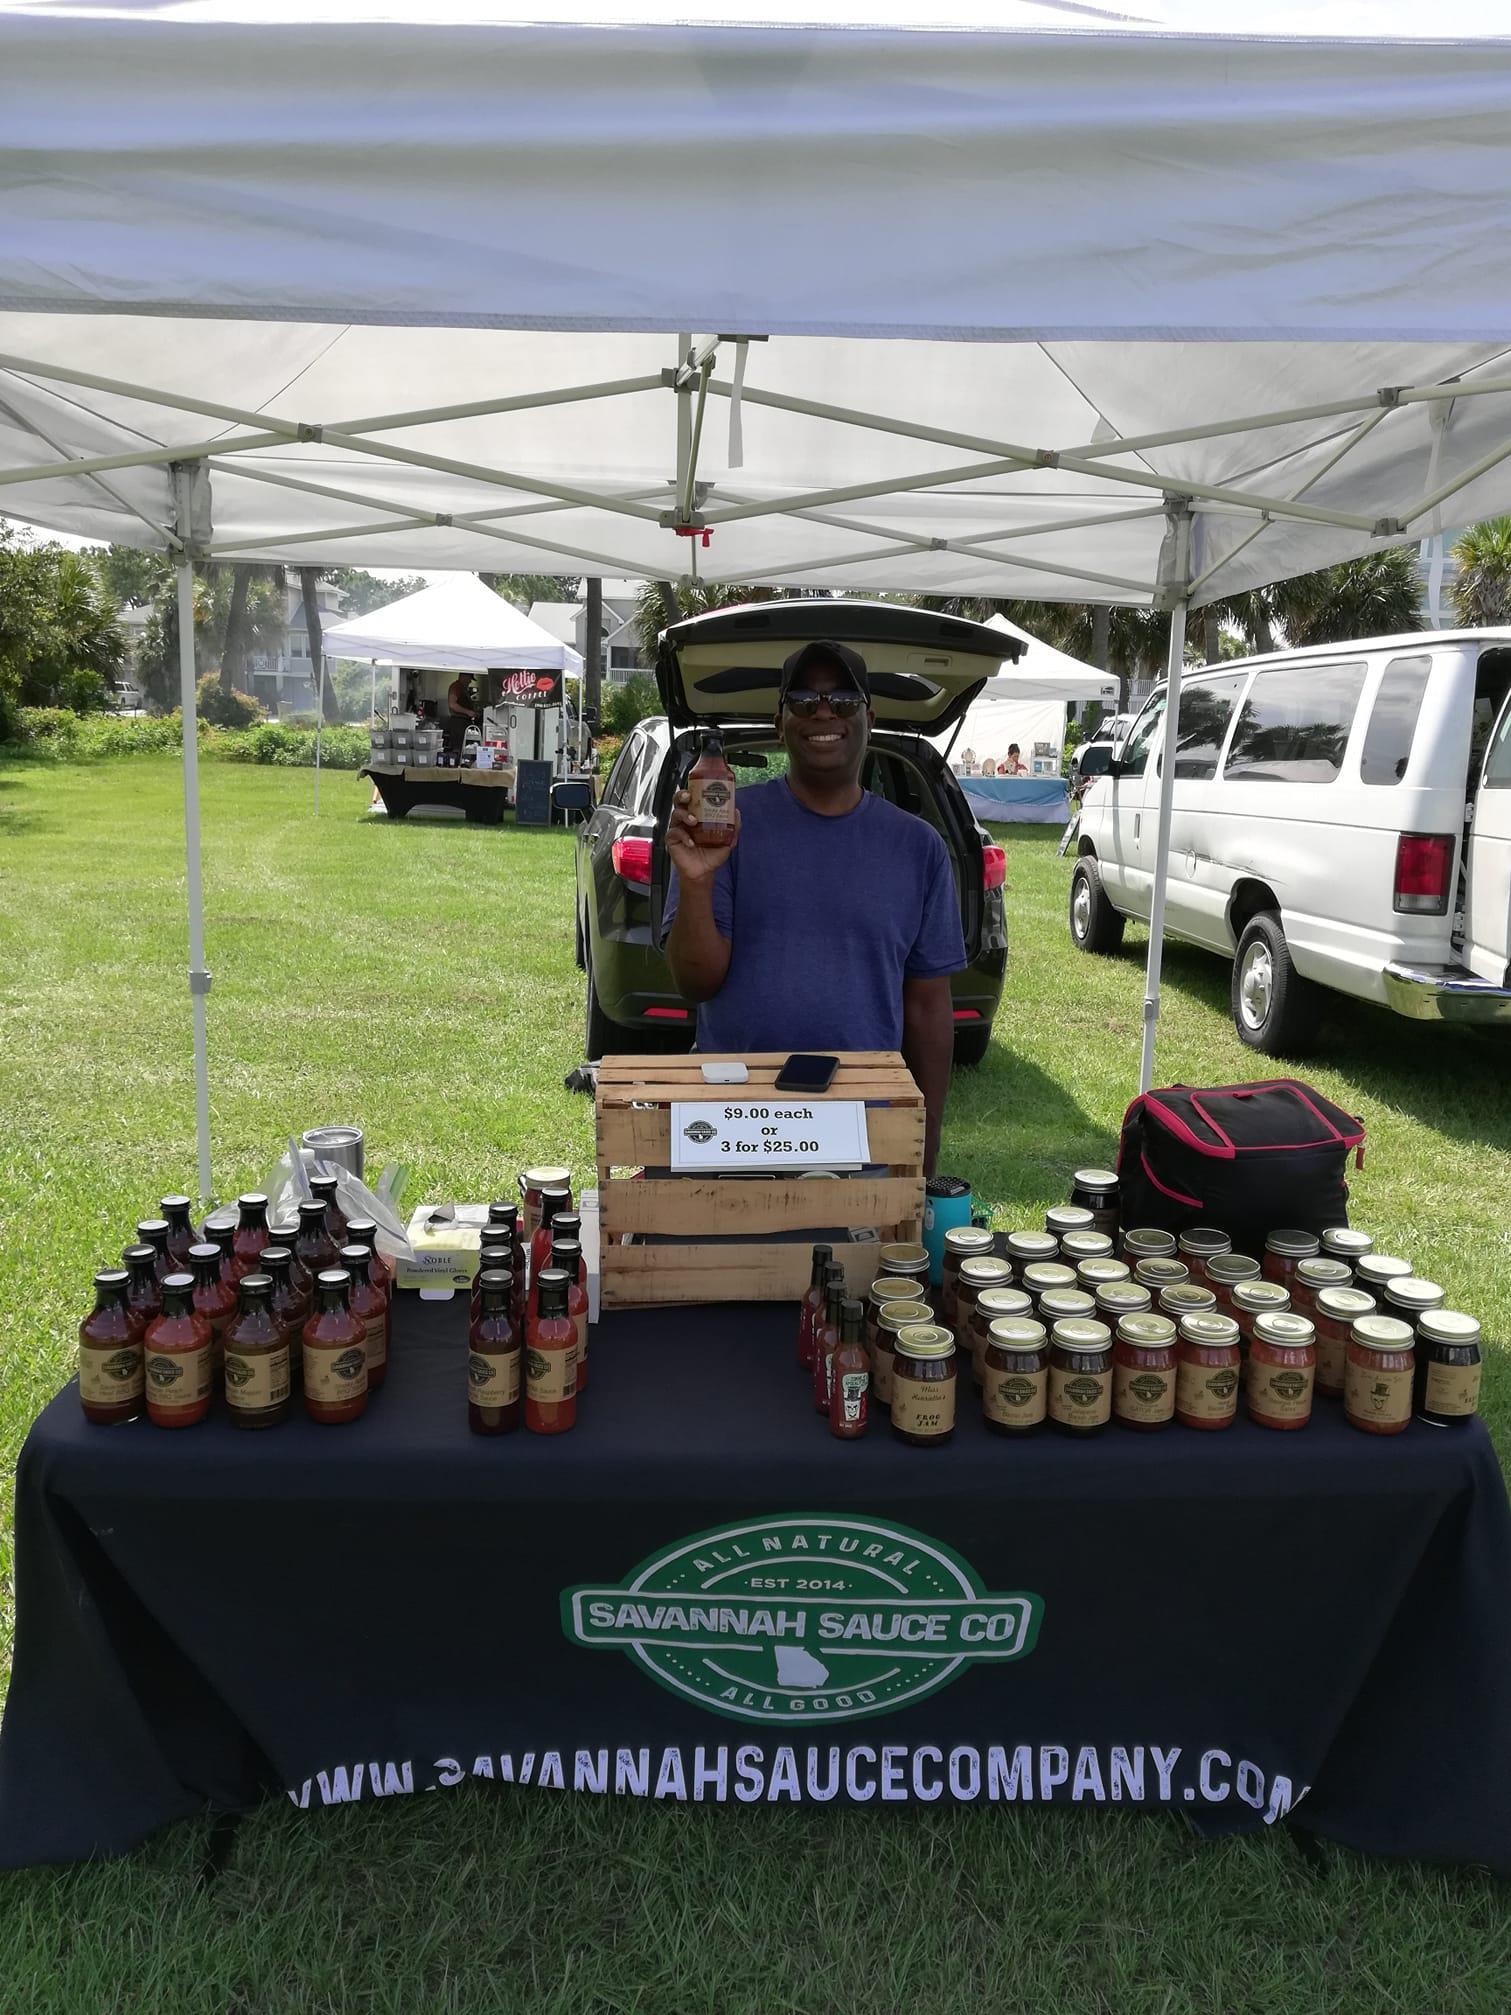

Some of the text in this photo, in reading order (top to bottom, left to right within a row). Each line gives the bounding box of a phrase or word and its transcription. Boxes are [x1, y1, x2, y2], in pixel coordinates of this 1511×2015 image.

[724, 1106, 814, 1120] $9.00 each
[760, 1126, 779, 1136] or
[720, 1139, 819, 1154] 3 for $25.00
[692, 1534, 922, 1575] ALL NATURAL
[750, 1577, 845, 1591] EST 2014
[588, 1601, 1017, 1643] SAVANNAH SAUCE CO
[720, 1685, 877, 1712] ALL GOOD
